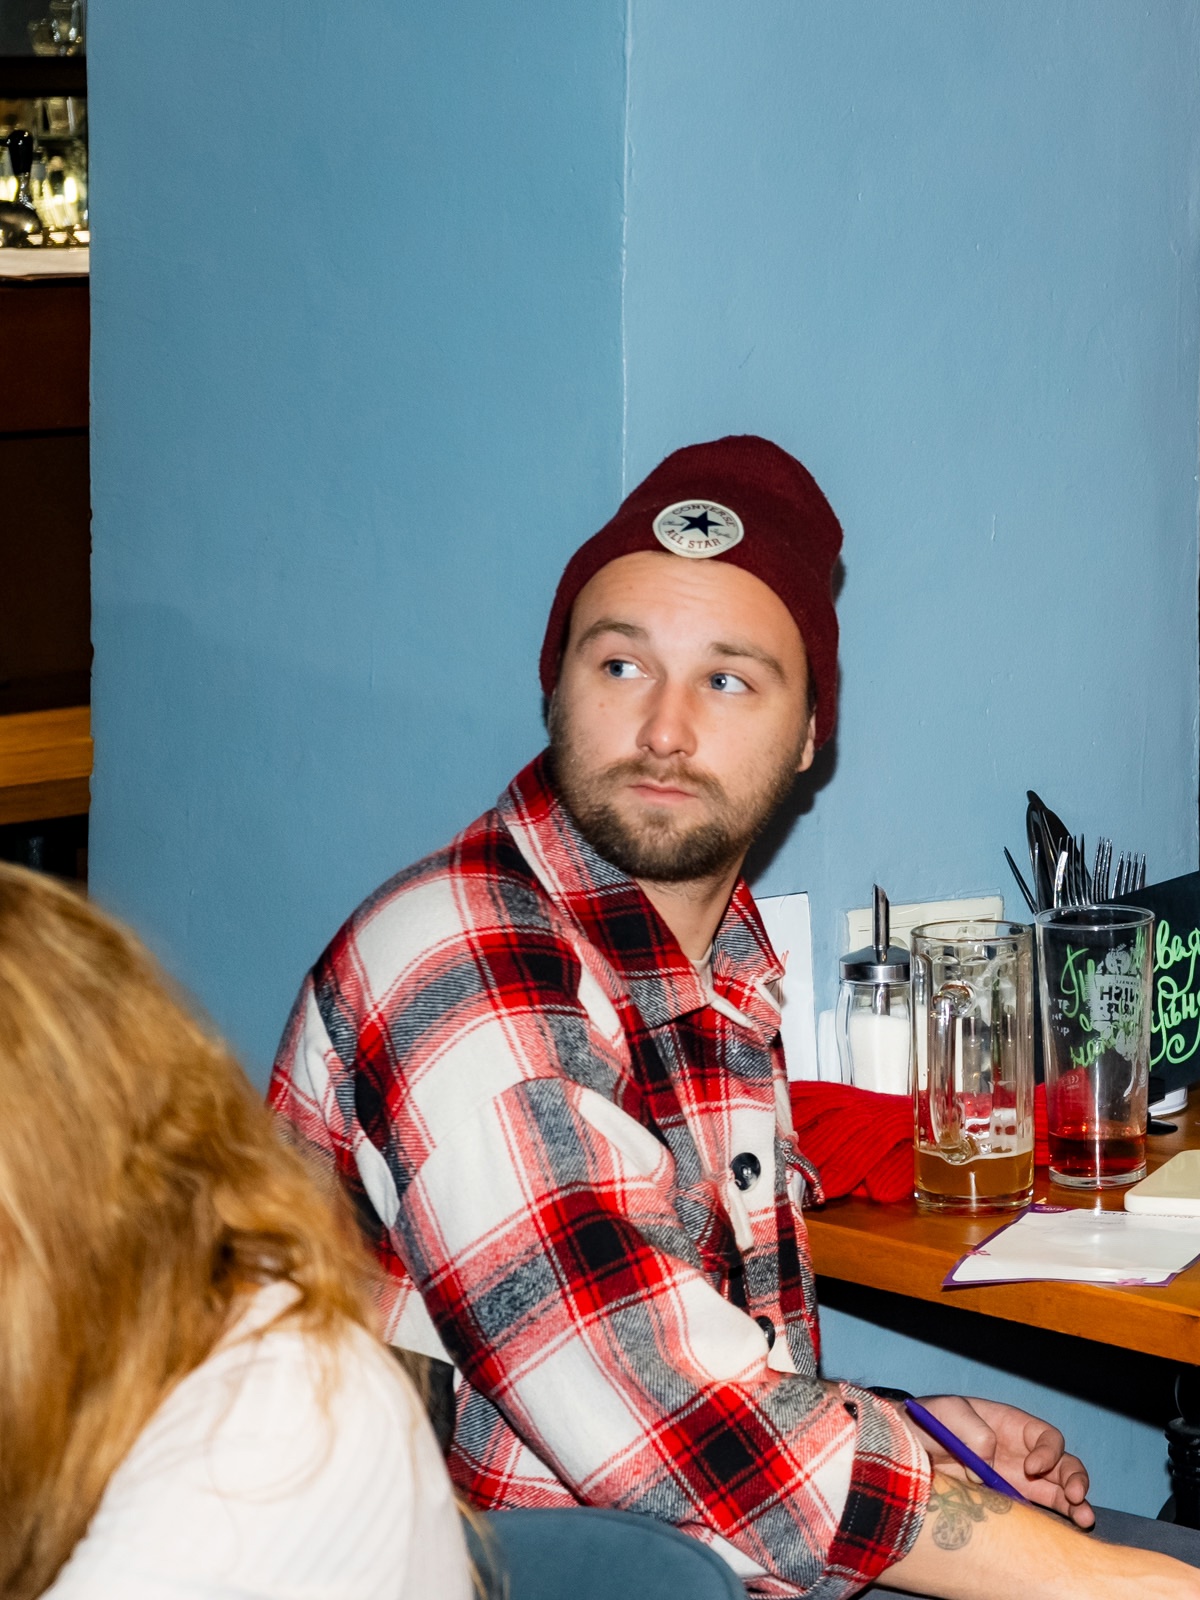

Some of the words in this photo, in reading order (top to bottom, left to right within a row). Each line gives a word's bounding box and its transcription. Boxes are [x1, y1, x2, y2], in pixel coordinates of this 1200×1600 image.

[672, 504, 736, 528] CONVERSE
[664, 529, 684, 545] ALL
[688, 538, 722, 549] STAR
